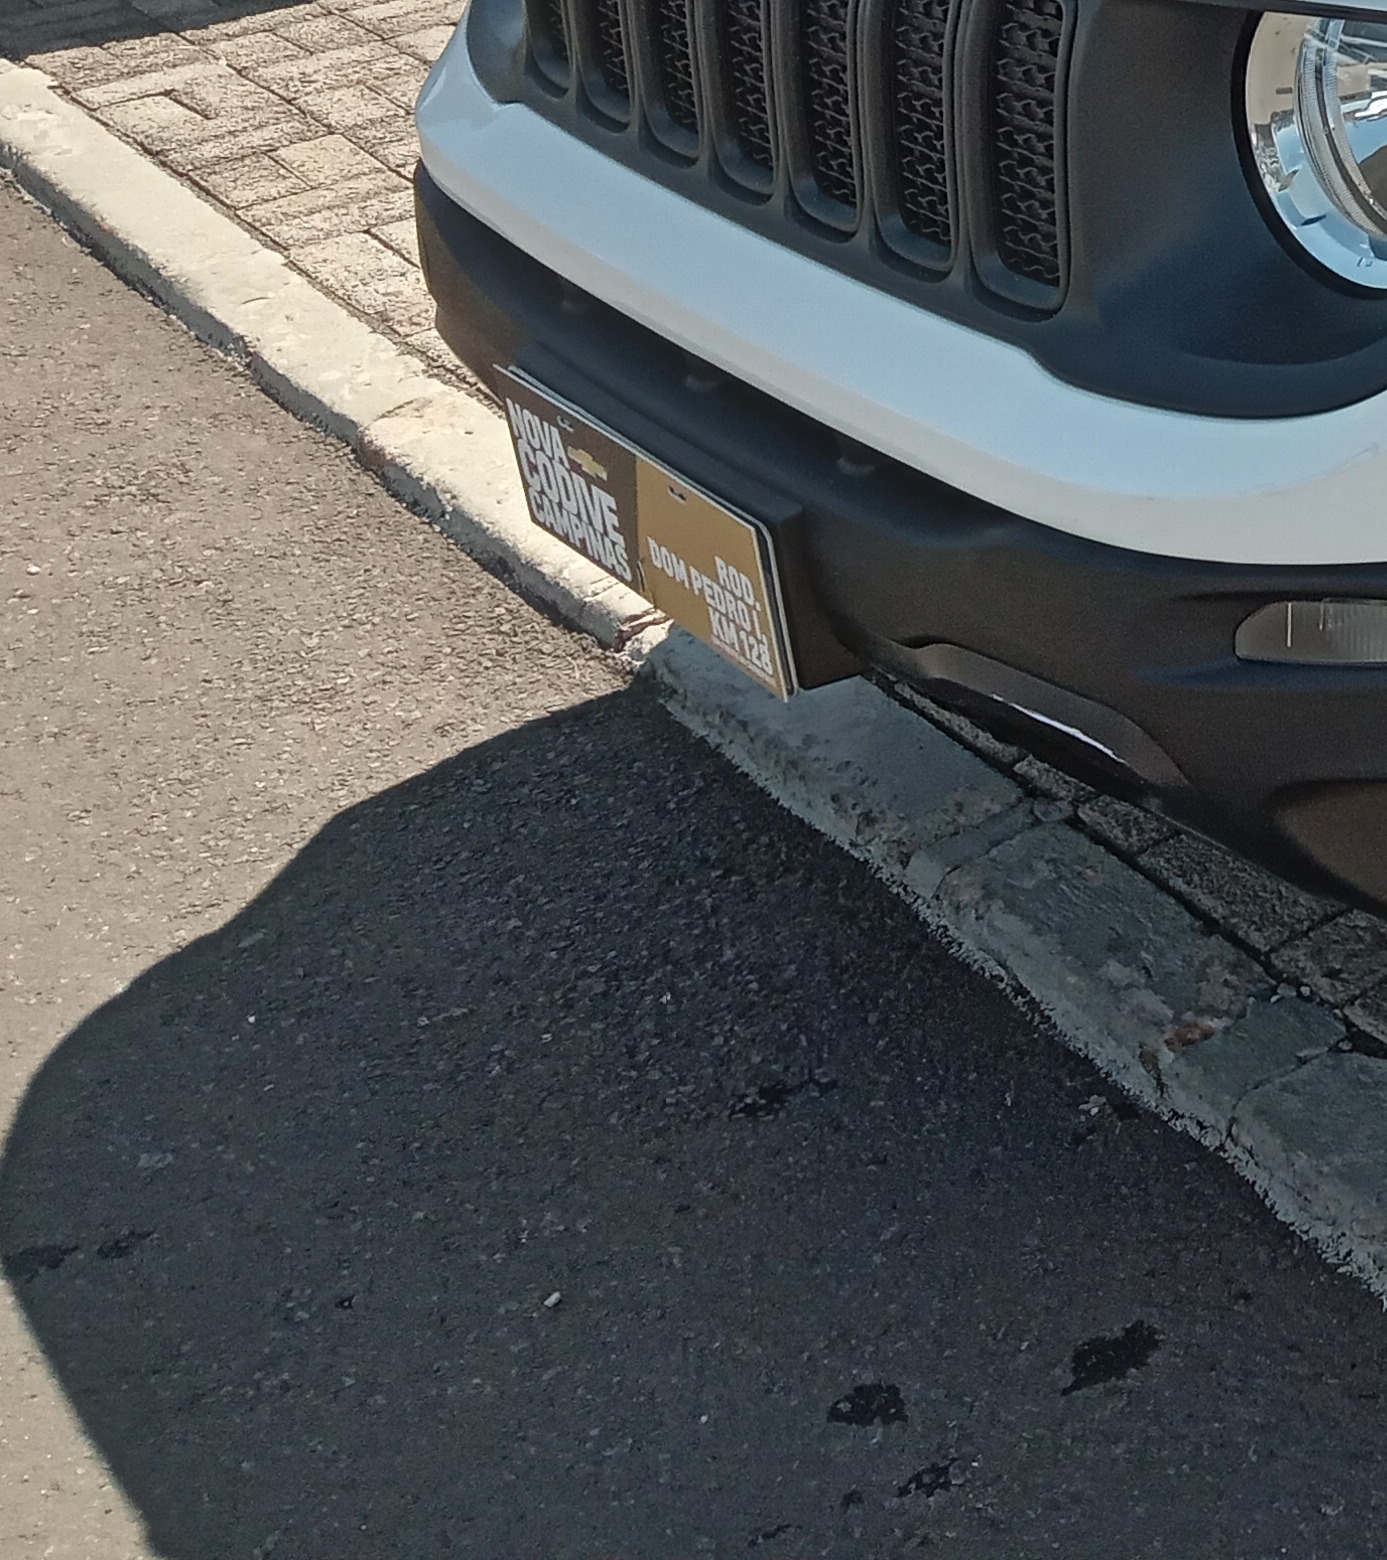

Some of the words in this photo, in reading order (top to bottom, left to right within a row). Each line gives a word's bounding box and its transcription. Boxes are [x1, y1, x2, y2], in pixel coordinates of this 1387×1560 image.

[506, 397, 571, 469] NOVA
[517, 439, 626, 550] CODIVE
[529, 486, 633, 583] CAMPINAS
[648, 536, 690, 590] DOM
[689, 565, 752, 633] PEDRO
[714, 555, 762, 612] ROD.
[708, 605, 741, 653] KM
[739, 630, 774, 675] 128
